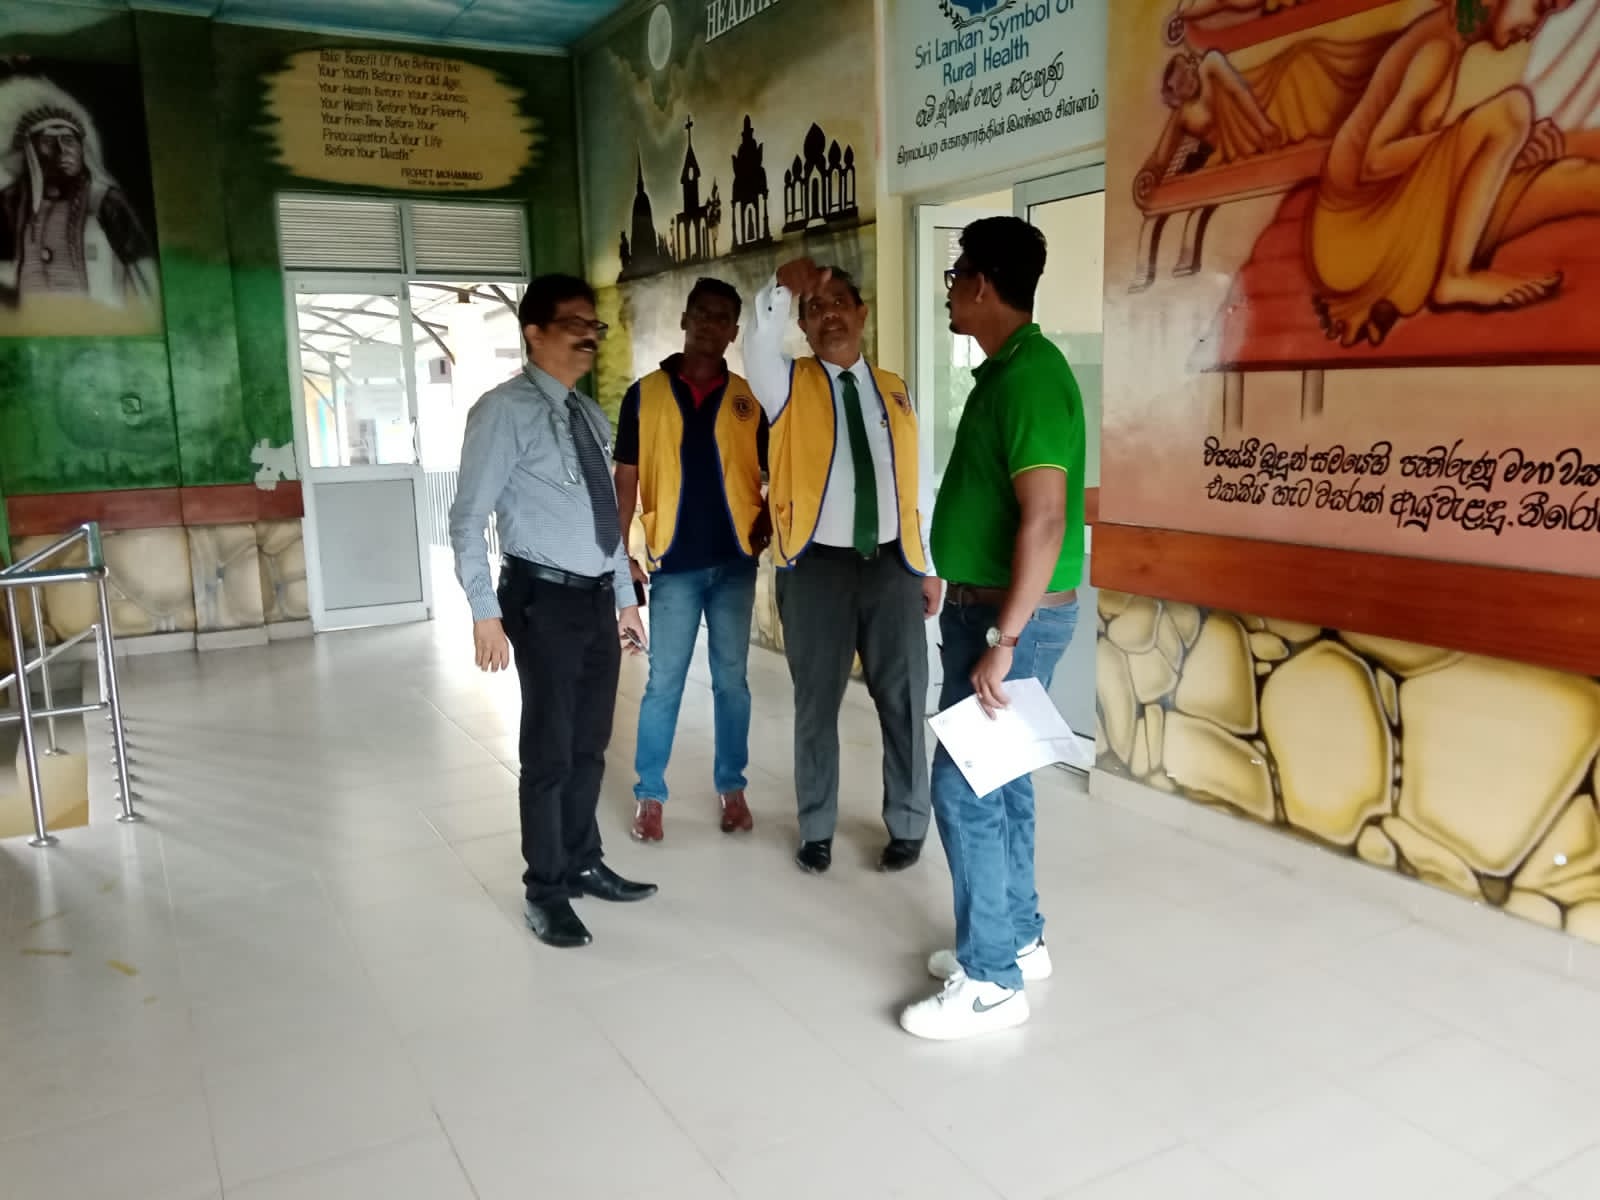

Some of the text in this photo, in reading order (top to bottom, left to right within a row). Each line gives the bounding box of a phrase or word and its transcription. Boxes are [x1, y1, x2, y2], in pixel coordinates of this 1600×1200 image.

[915, 42, 931, 69] Sri
[935, 30, 983, 62] Lankan
[989, 0, 1050, 42] Symbol
[944, 34, 1029, 86] Rural Health
[318, 64, 338, 78] Your
[343, 67, 369, 80] Youth
[372, 69, 400, 83] Before
[404, 72, 423, 85] Your
[318, 82, 338, 94] Your
[343, 84, 371, 97] Health
[375, 85, 402, 98] Before
[408, 88, 429, 99] Your
[320, 97, 339, 109] Your
[343, 98, 373, 112] Wealth
[377, 100, 407, 114] Before
[409, 102, 429, 116] Your
[1007, 108, 1052, 133] இலங்கை
[1055, 89, 1099, 119] சின்னம்
[321, 112, 342, 125] Your
[385, 116, 413, 129] Before
[417, 119, 439, 131] Your
[401, 134, 420, 146] Your
[424, 135, 443, 148] Life
[325, 144, 356, 157] Before
[357, 146, 378, 159] Your
